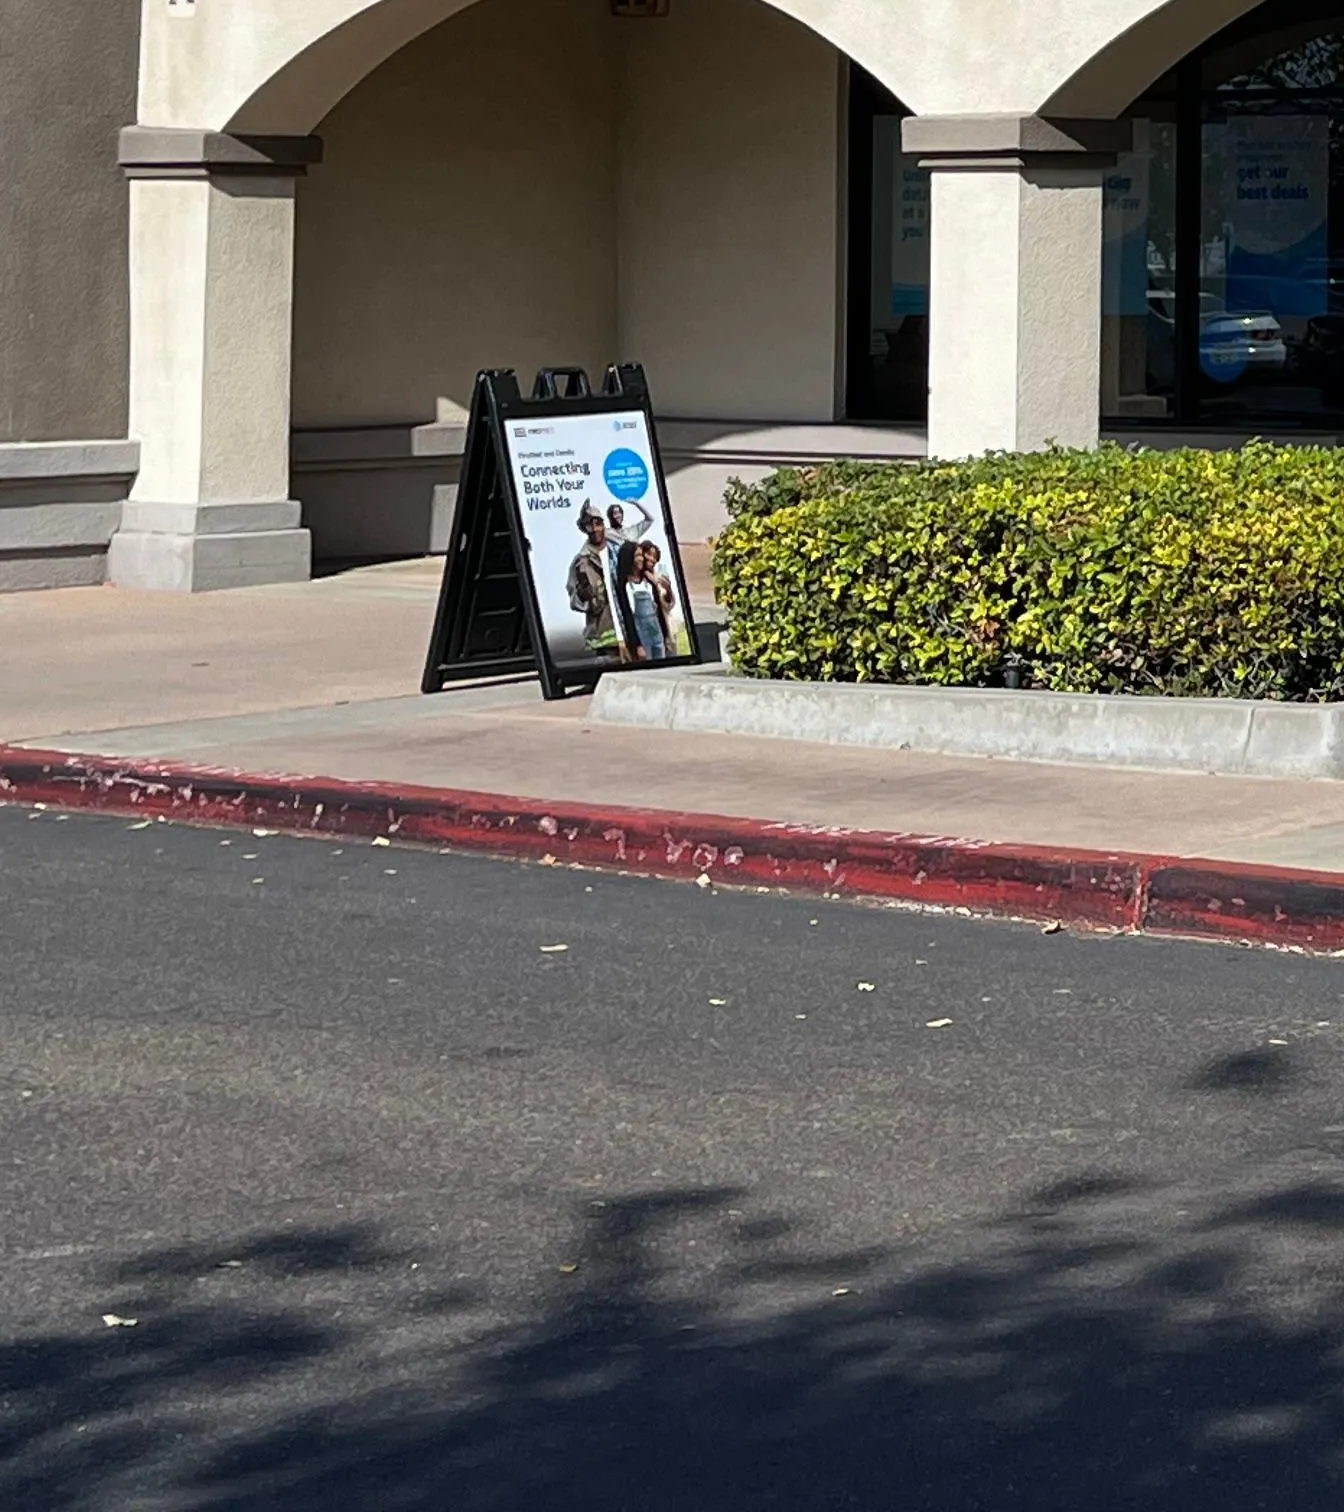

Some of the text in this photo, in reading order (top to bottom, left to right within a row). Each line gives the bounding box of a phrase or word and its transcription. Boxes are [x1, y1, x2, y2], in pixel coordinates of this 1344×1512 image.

[1237, 183, 1309, 200] best deals
[521, 461, 590, 478] Connecting
[523, 478, 585, 495] Both Your
[527, 495, 571, 512] Worlds
